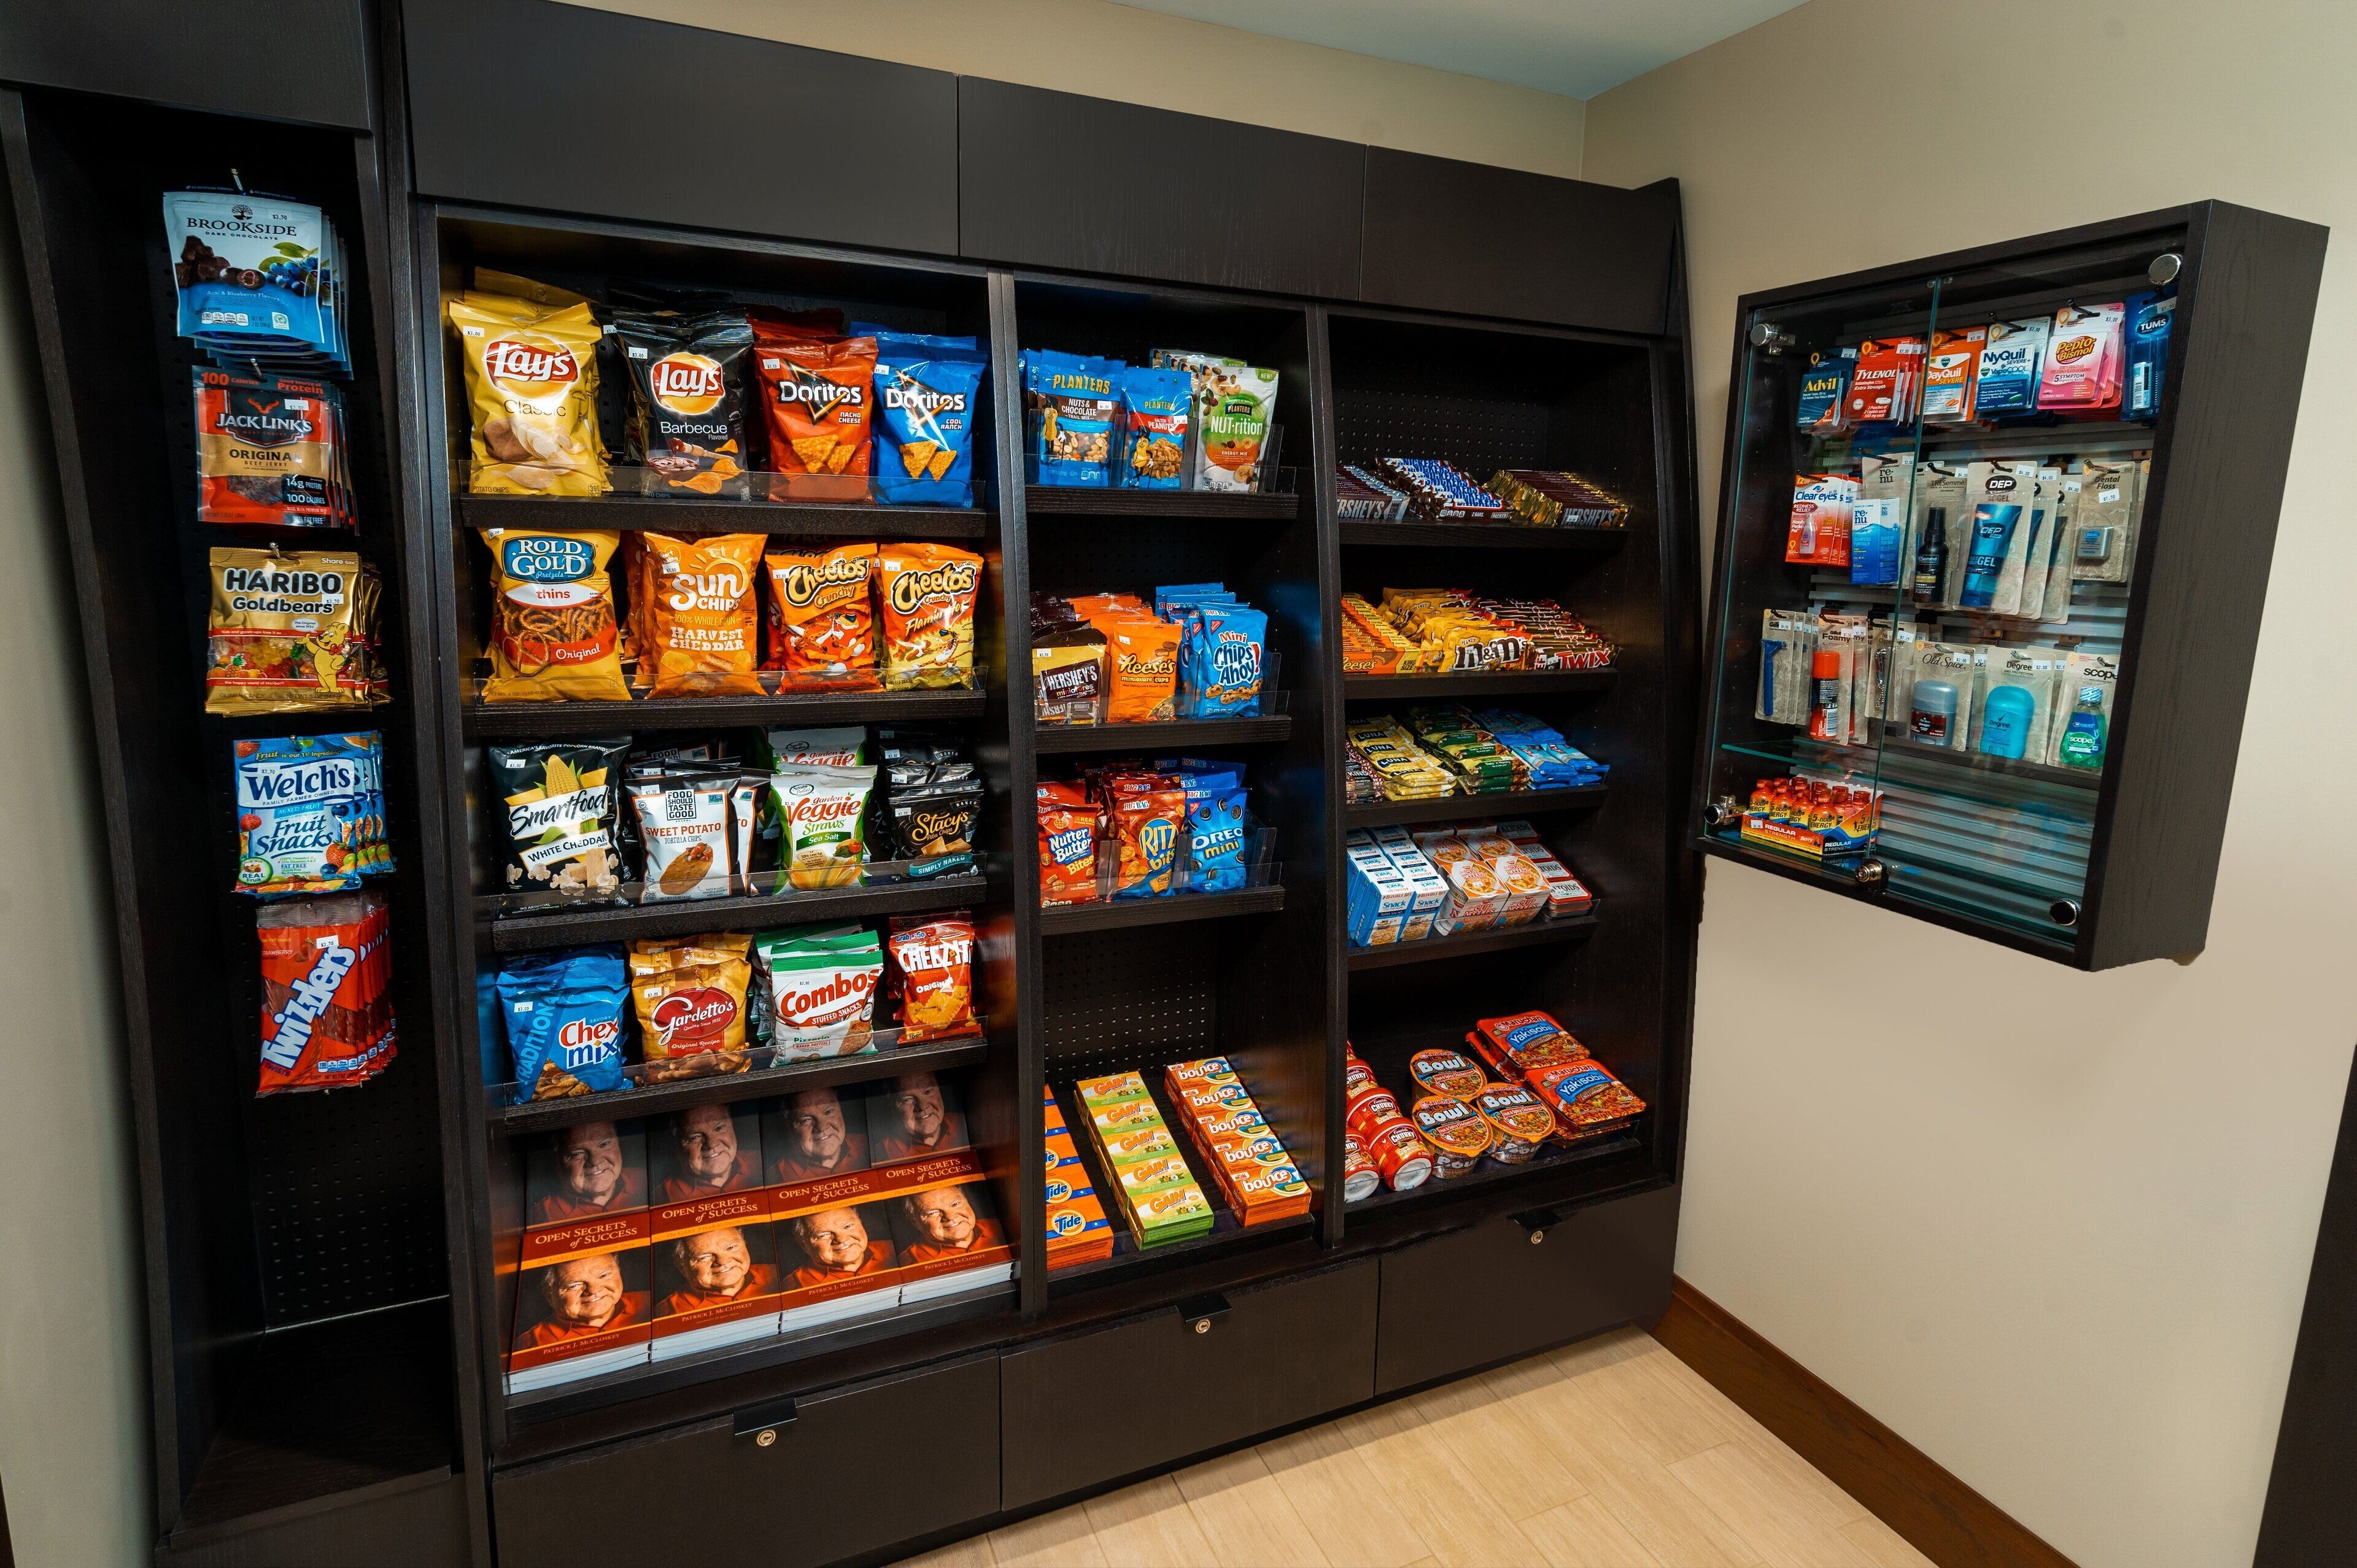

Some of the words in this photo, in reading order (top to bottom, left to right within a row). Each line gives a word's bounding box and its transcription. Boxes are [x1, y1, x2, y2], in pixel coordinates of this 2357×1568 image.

[187, 217, 297, 237] BROOKSIDE
[2140, 319, 2166, 331] TUMS
[2056, 336, 2097, 355] Pepto-
[2057, 344, 2094, 362] Bismol
[493, 342, 571, 381] Lay's
[1983, 347, 2026, 365] NyQuil
[201, 372, 230, 385] 100
[1856, 369, 1897, 380] TYLENOL
[1926, 367, 1962, 382] DayQuil
[1991, 365, 2028, 376] VapoCOOL
[277, 382, 324, 395] Protein
[659, 363, 720, 397] Lay's
[1051, 374, 1111, 395] PLANTERS
[1804, 377, 1837, 392] Advil
[778, 379, 862, 404] Doritos
[886, 388, 966, 411] Doritos
[1061, 406, 1097, 417] CHOCOLATE
[1068, 398, 1085, 408] NUTS
[1144, 401, 1176, 412] PLANTERS
[1228, 405, 1251, 414] PLANTERS
[217, 414, 261, 430] JACK
[261, 415, 312, 433] LINK'S
[660, 421, 728, 434] Barbecue
[1148, 422, 1175, 431] PEANUTS
[229, 449, 303, 463] ORIGINAL
[1989, 479, 2014, 489] DEP
[287, 494, 305, 503] 100
[1795, 492, 1818, 501] Clear
[1819, 493, 1837, 503] eyes
[517, 539, 583, 555] ROLD
[511, 555, 587, 576] GOLD
[1977, 556, 1996, 566] GEL
[223, 568, 344, 595] HARIBO
[535, 571, 564, 579] Pretzels
[785, 558, 870, 606] Cheetos
[536, 588, 571, 600] thins
[669, 573, 745, 611] Sun
[814, 585, 856, 608] Crunchy
[891, 561, 977, 614] Cheetos
[232, 595, 335, 614] Goldbears
[697, 597, 741, 611] CHIPS
[670, 626, 745, 641] HARVEST
[1218, 630, 1247, 644] Mini
[1822, 633, 1851, 643] Foamy
[555, 643, 601, 661] Original
[669, 638, 745, 651] CHEDDAR
[1118, 652, 1176, 674] Reese's
[1213, 643, 1254, 667] Chips
[1556, 651, 1610, 670] TWIX
[1922, 654, 1940, 665] Old
[1940, 656, 1964, 670] Spice
[2006, 660, 2032, 673] Degree
[2083, 666, 2118, 680] scope
[1047, 665, 1098, 690] HERSHEY'S
[1056, 684, 1094, 697] miniatures
[244, 763, 350, 801] Welch's
[286, 794, 312, 803] FARMER
[668, 790, 692, 799] FOOD
[813, 795, 843, 806] garden
[277, 805, 300, 814] MIXED
[301, 802, 321, 811] FRUIT
[509, 784, 610, 837] Smartfood
[786, 797, 862, 828] Veggie
[271, 814, 327, 839] Fruit
[645, 826, 678, 838] SWEET
[681, 823, 721, 835] POTATO
[802, 819, 845, 836] Straws
[911, 811, 971, 842] Stacy's
[1764, 824, 1796, 836] REGULAR
[255, 830, 334, 856] Snacks
[824, 833, 840, 841] Salt
[1048, 827, 1088, 852] Nutter
[1140, 824, 1177, 858] RITZ
[1191, 827, 1243, 850] OREO
[527, 844, 562, 863] WHITE
[562, 835, 607, 851] CHEDDAR
[1055, 838, 1093, 862] Butter
[1204, 838, 1240, 859] mini
[918, 862, 942, 875] SIMPLY
[943, 854, 966, 866] NAKED
[1066, 855, 1094, 876] Bites
[1382, 900, 1406, 909] Snack
[1417, 898, 1440, 906] Snack
[780, 968, 880, 1018] Combos
[589, 1015, 612, 1024] SAVORY
[651, 997, 734, 1046] Gardetto's
[811, 1013, 837, 1025] STUFFED
[838, 1002, 862, 1017] SNACKS
[1506, 1015, 1543, 1027] Maruchan
[560, 1017, 619, 1047] Chex
[1510, 1024, 1553, 1045] Yakisoba
[699, 1038, 721, 1046] Recipe
[567, 1040, 618, 1069] mix
[1177, 1062, 1221, 1081] bounce
[1417, 1056, 1466, 1074] Bowl
[1550, 1064, 1594, 1076] Maruchan
[1560, 1073, 1605, 1096] Yakisoba
[1370, 1101, 1394, 1112] CHUNKY
[1482, 1091, 1534, 1108] Bowl
[1418, 1102, 1470, 1126] Bowl
[1390, 1130, 1415, 1143] CHUNKY
[1223, 1140, 1273, 1164] bounce
[1133, 1159, 1169, 1183] GAIN
[778, 1187, 810, 1200] OPEN
[811, 1177, 859, 1194] SECRETS
[1241, 1169, 1291, 1194] bounce
[822, 1183, 870, 1199] SUCCESS
[662, 1207, 696, 1219] OPEN
[697, 1197, 748, 1213] SECRETS
[1149, 1189, 1186, 1214] GAIN
[708, 1203, 758, 1219] SUCCESS
[535, 1230, 573, 1245] OPEN
[574, 1221, 627, 1238] SECRETS
[1055, 1215, 1082, 1234] Tide
[584, 1227, 638, 1245] SUCCESS
